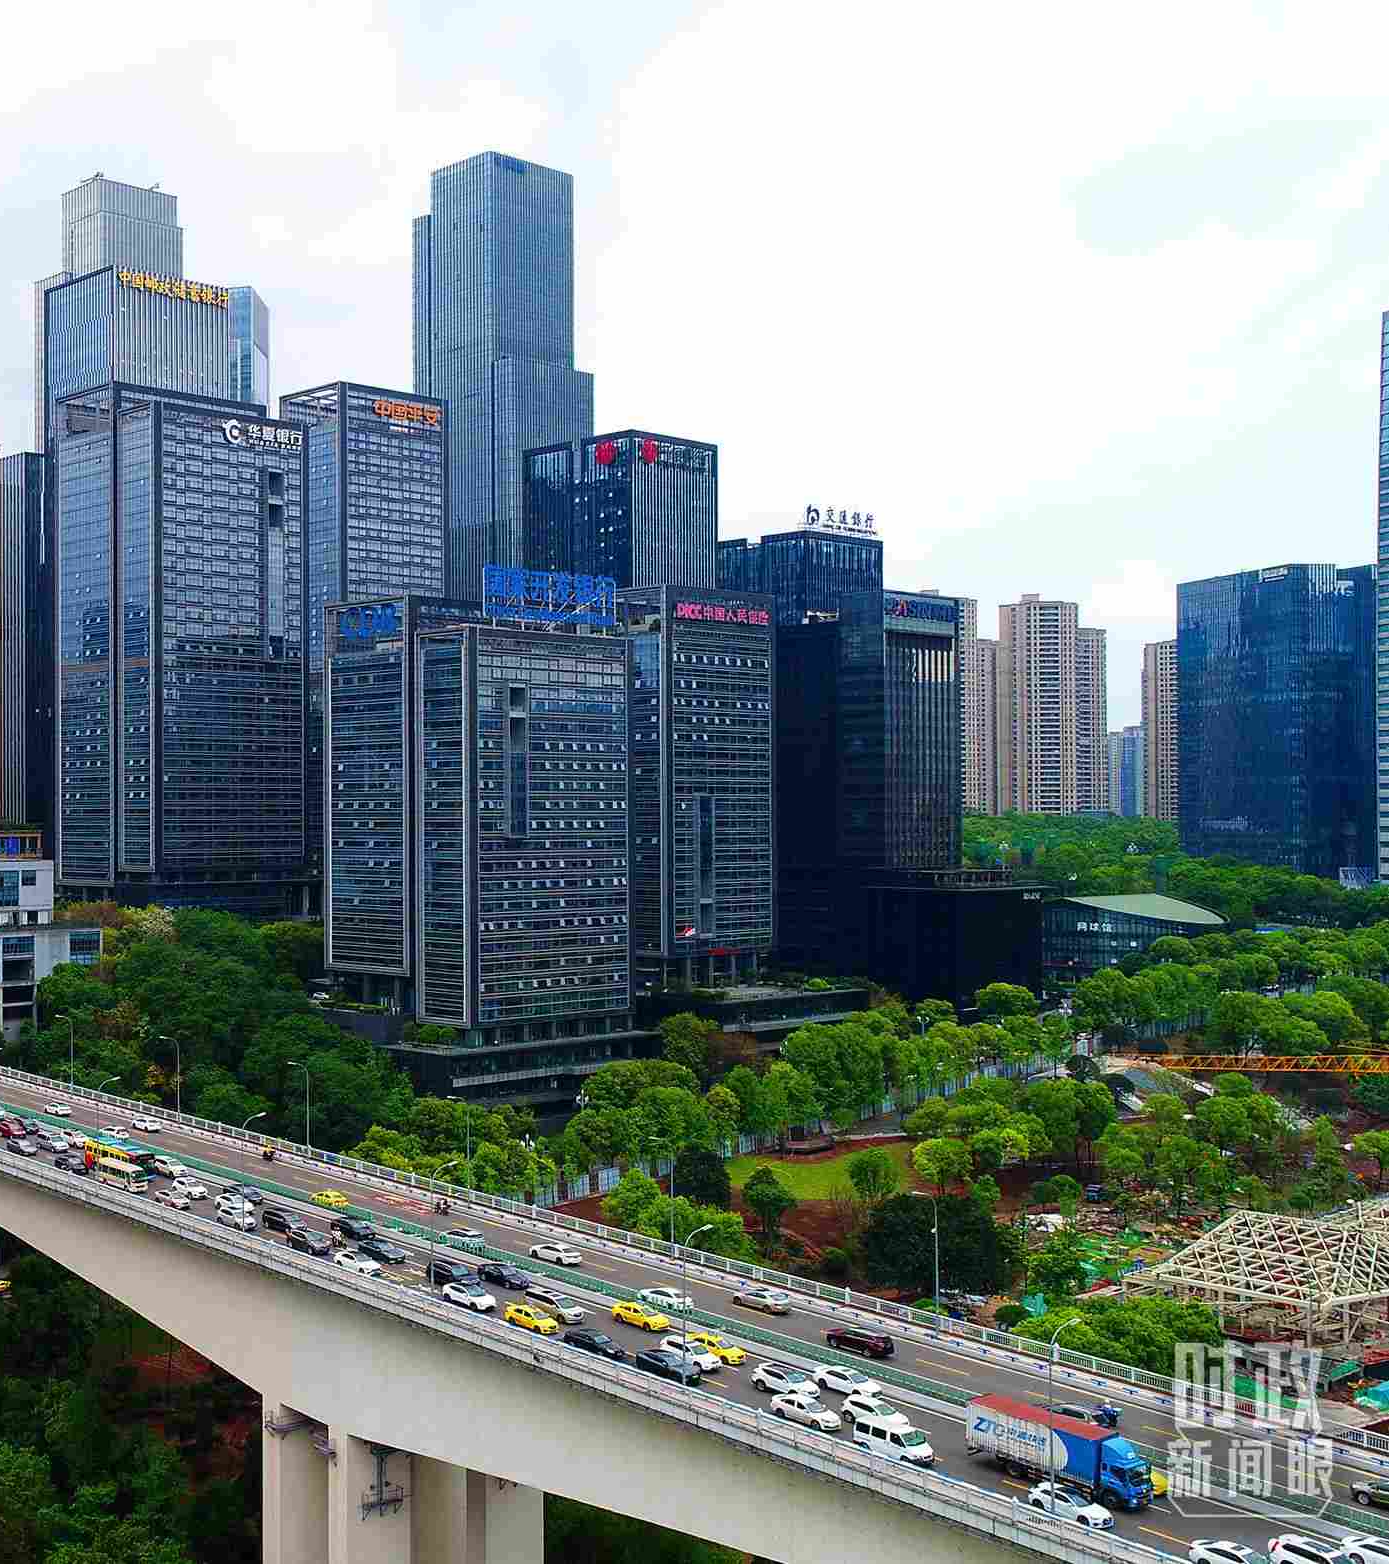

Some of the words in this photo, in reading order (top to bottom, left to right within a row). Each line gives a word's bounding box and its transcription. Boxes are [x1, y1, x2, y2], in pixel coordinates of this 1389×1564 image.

[373, 399, 442, 425] 中国平安
[247, 423, 303, 445] 华夏银行
[973, 1416, 1011, 1443] ZTO
